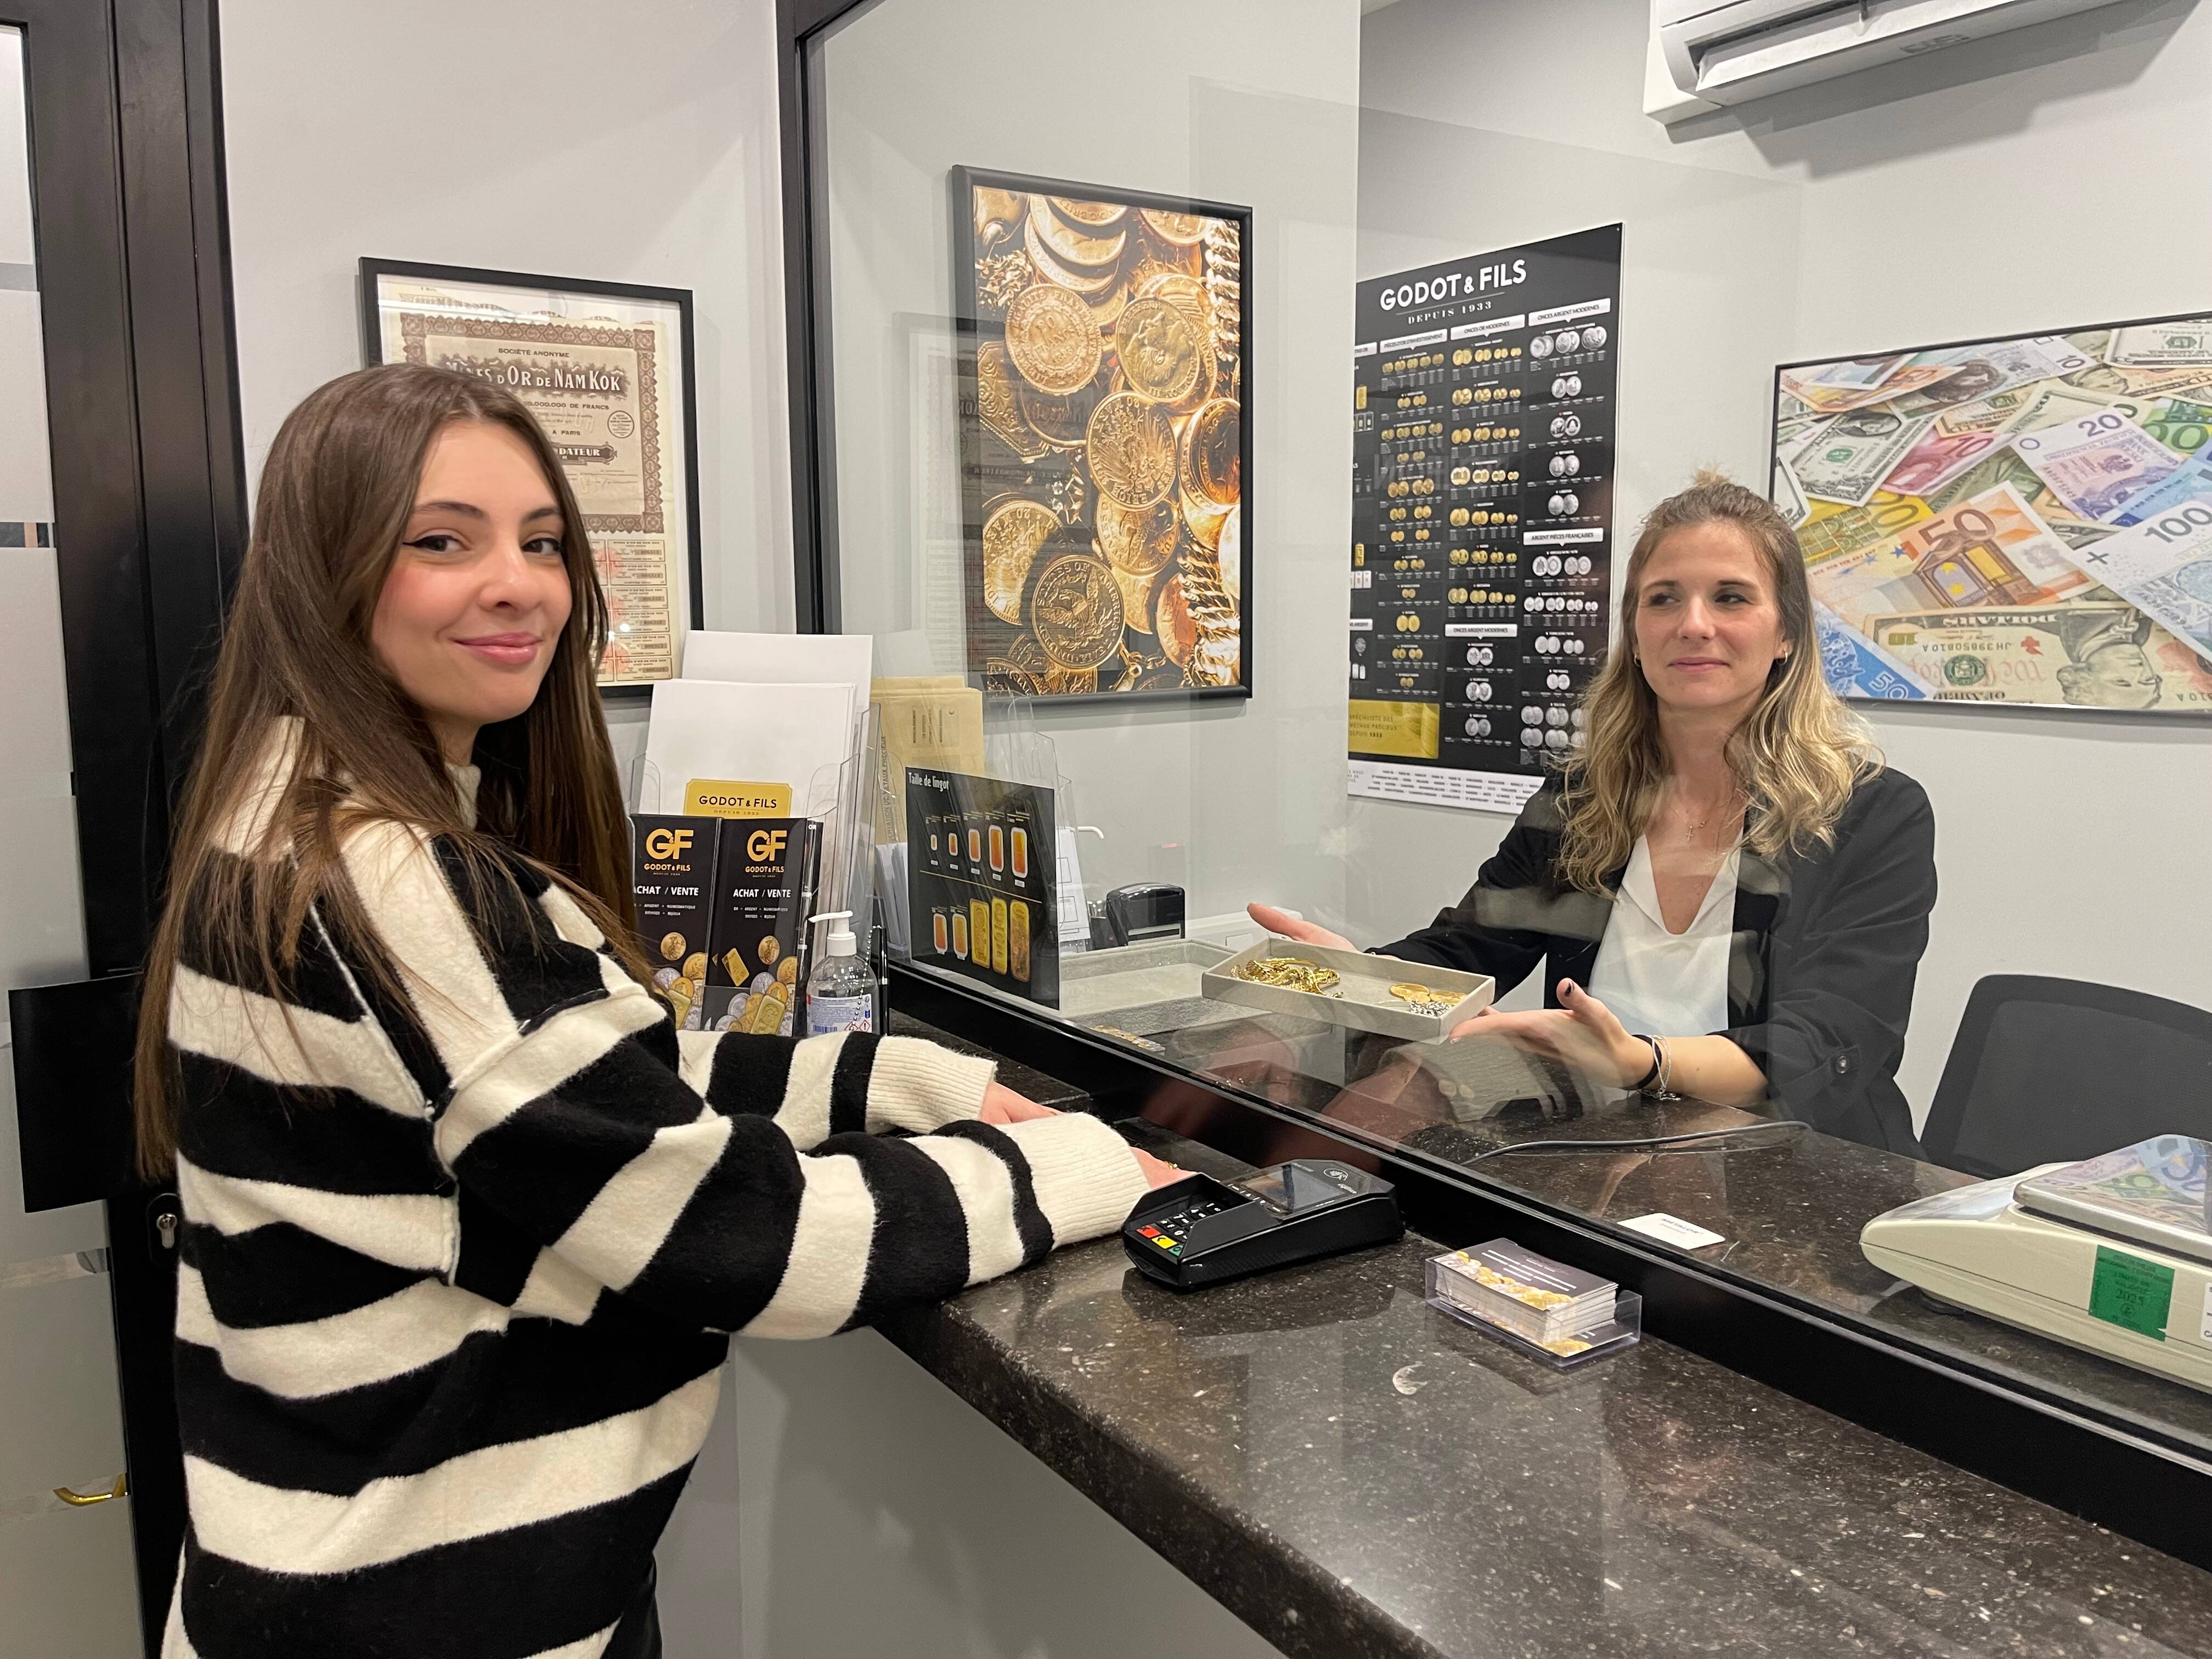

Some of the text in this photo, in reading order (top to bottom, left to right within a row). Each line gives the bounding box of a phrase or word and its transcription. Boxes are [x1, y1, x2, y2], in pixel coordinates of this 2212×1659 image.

[1380, 258, 1527, 311] GODOT & FILS
[1408, 301, 1492, 325] DEPUIS 1933
[498, 347, 570, 358] SOCIÉTÉ ANONYME
[536, 376, 551, 387] DE
[2078, 414, 2123, 438] 20
[1918, 509, 1997, 547] 50
[2145, 507, 2212, 543] 100
[1942, 613, 2059, 628] DOLLARS
[1868, 670, 1909, 699] 50
[908, 771, 950, 792] Taille de lingot
[699, 795, 745, 807] GODOT
[753, 798, 777, 809] FILS
[644, 863, 672, 872] GODOT
[664, 887, 669, 895] /
[670, 887, 699, 896] VENTE
[732, 889, 792, 898] ACHAT / VENTE
